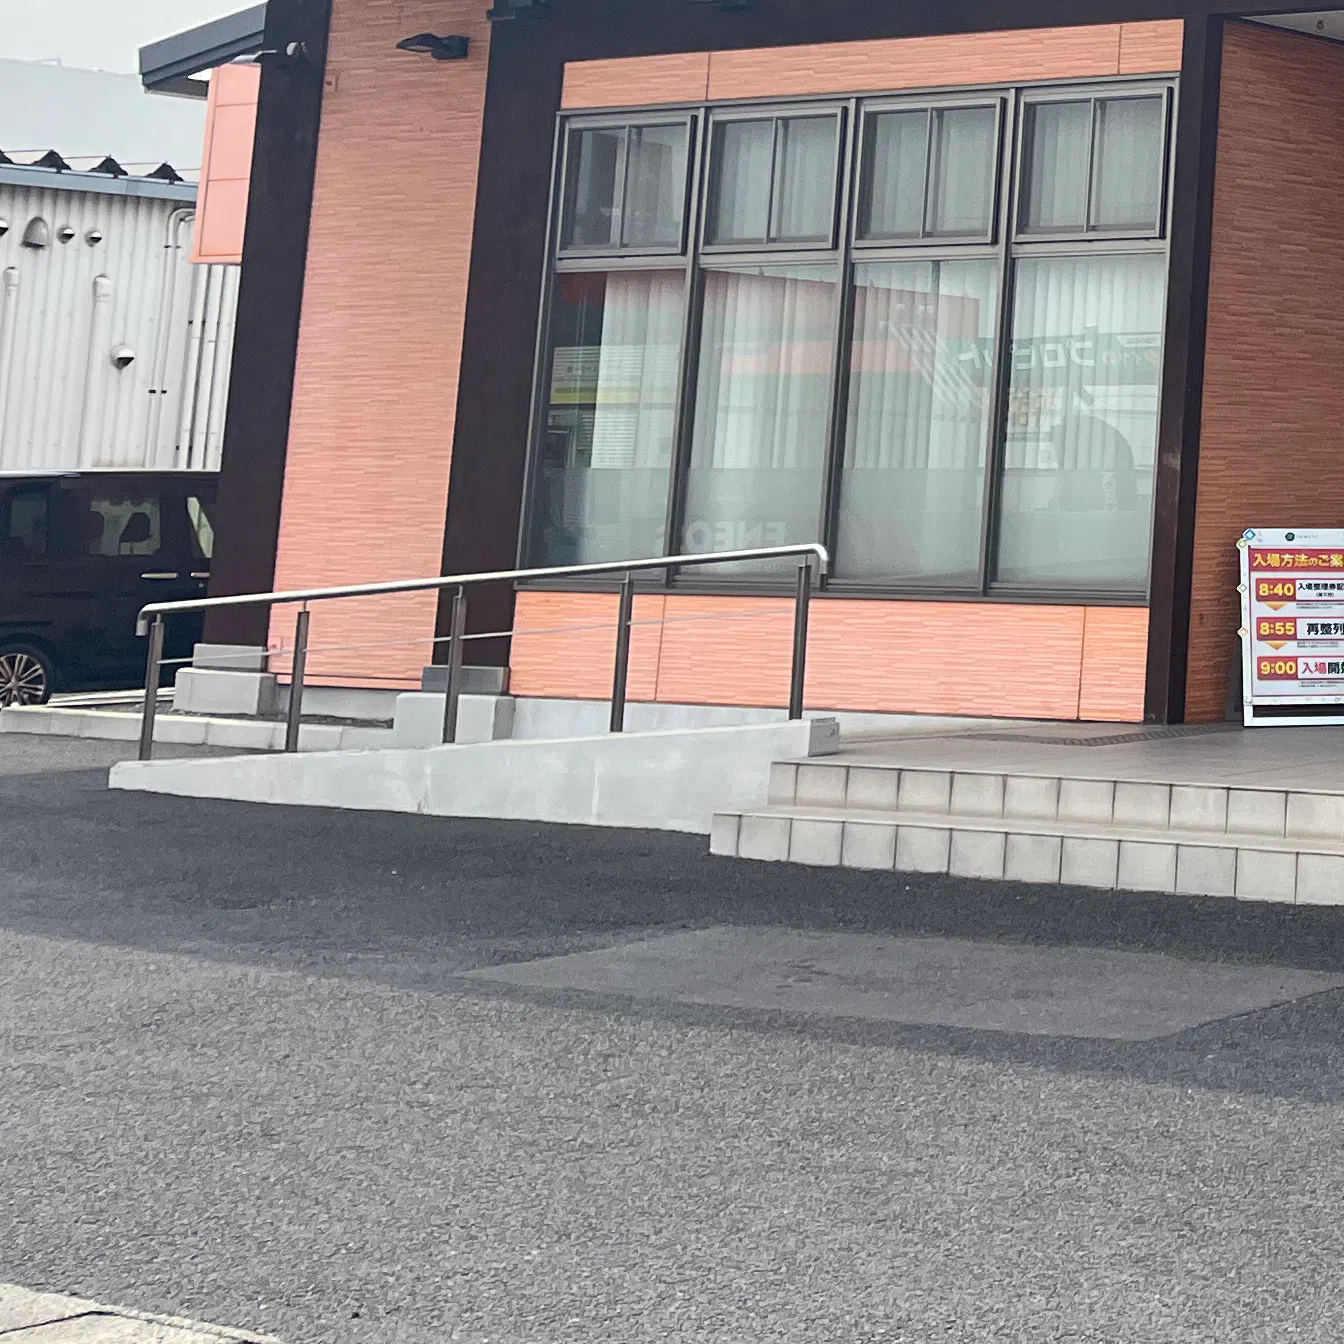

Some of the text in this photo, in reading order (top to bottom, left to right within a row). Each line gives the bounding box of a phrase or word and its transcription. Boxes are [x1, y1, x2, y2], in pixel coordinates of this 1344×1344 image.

[1259, 583, 1294, 596] 8:40
[1260, 622, 1295, 636] 8:55
[1260, 661, 1296, 675] 9:00
